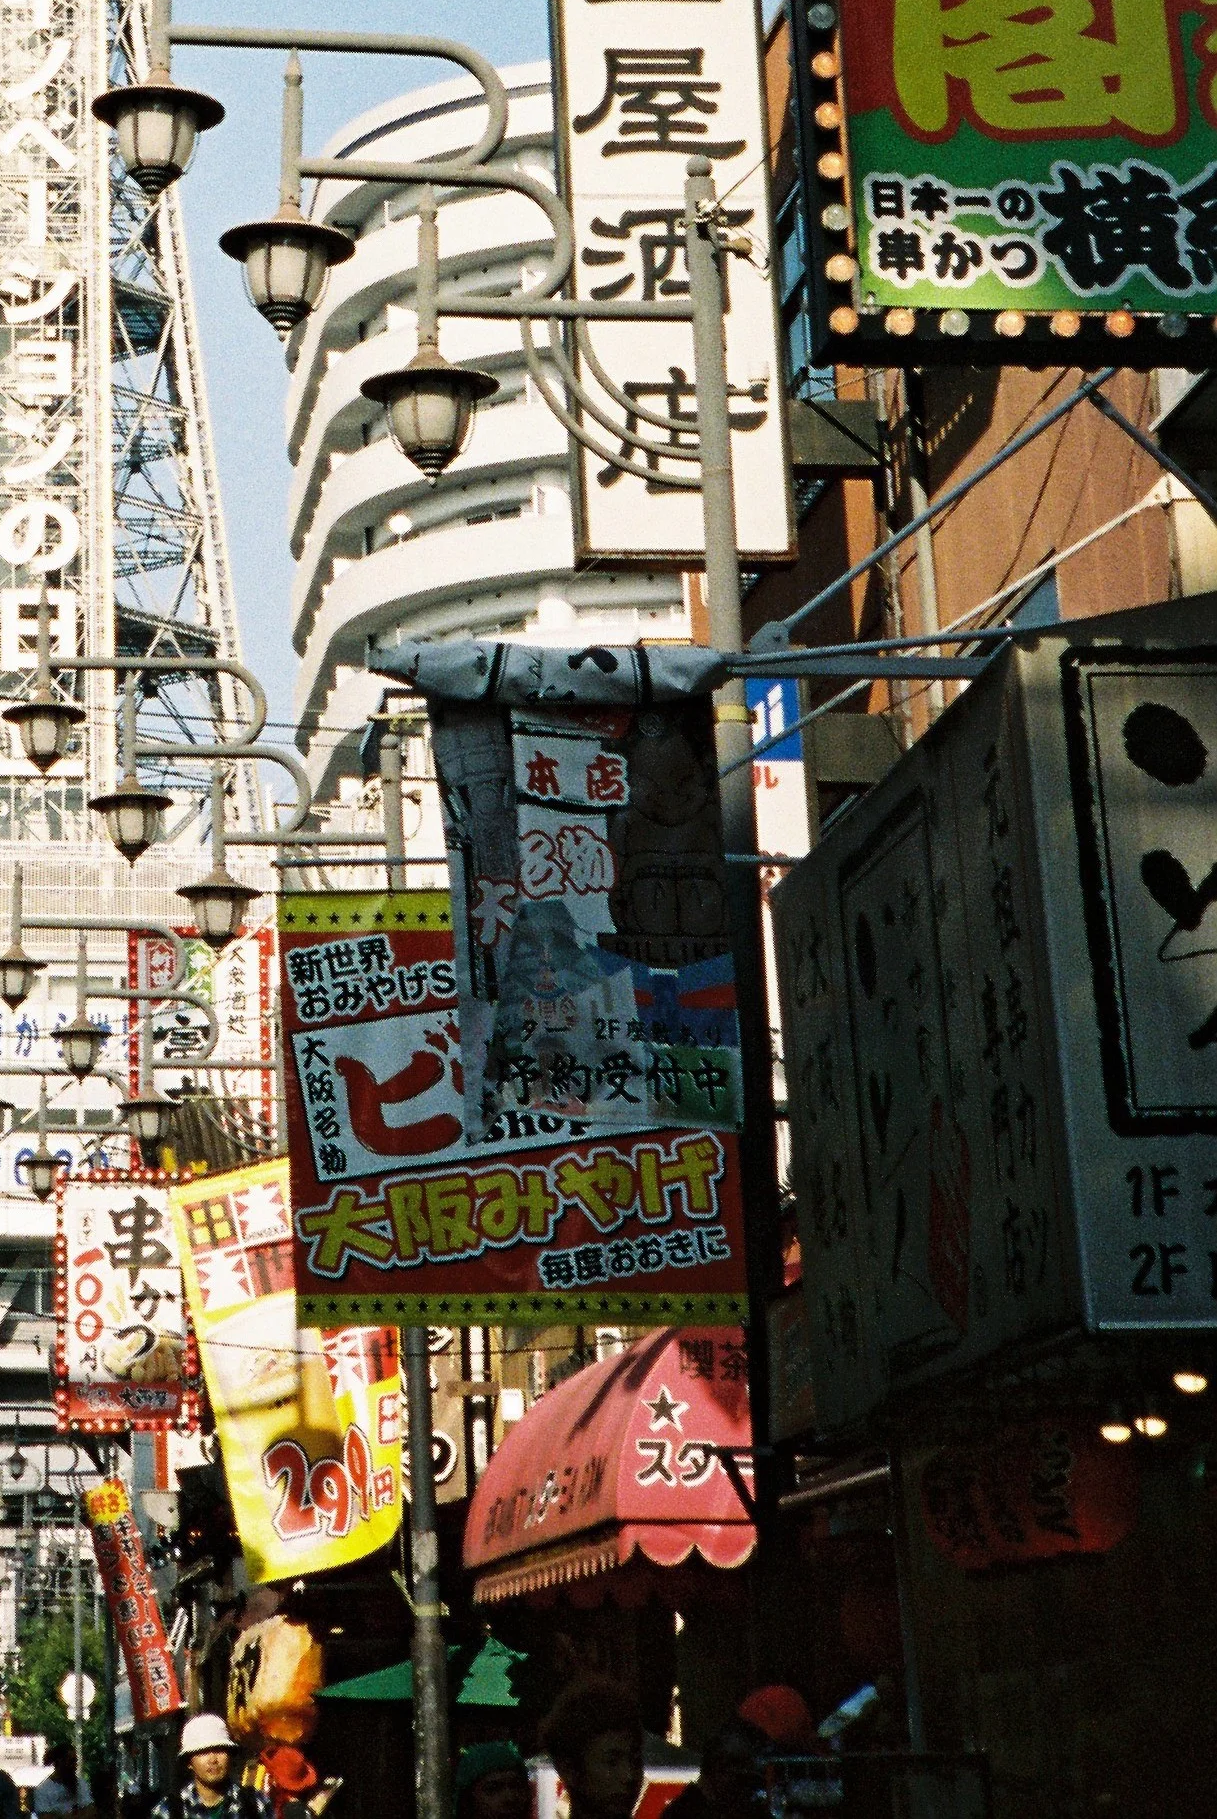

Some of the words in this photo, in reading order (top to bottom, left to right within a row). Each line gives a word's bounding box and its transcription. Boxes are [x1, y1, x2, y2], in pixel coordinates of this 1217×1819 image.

[870, 180, 1036, 221] 日本一の
[875, 233, 1041, 279] 串かつ
[525, 750, 626, 801] 本店
[290, 937, 389, 983] 新世界
[300, 1037, 348, 1175] 大阪名物
[301, 1137, 720, 1270] 大阪みやげ
[1126, 1165, 1180, 1216] 1F
[103, 1195, 177, 1363] 串かつ
[541, 1228, 728, 1285] 毎度おおきに
[1128, 1243, 1188, 1295] 2F
